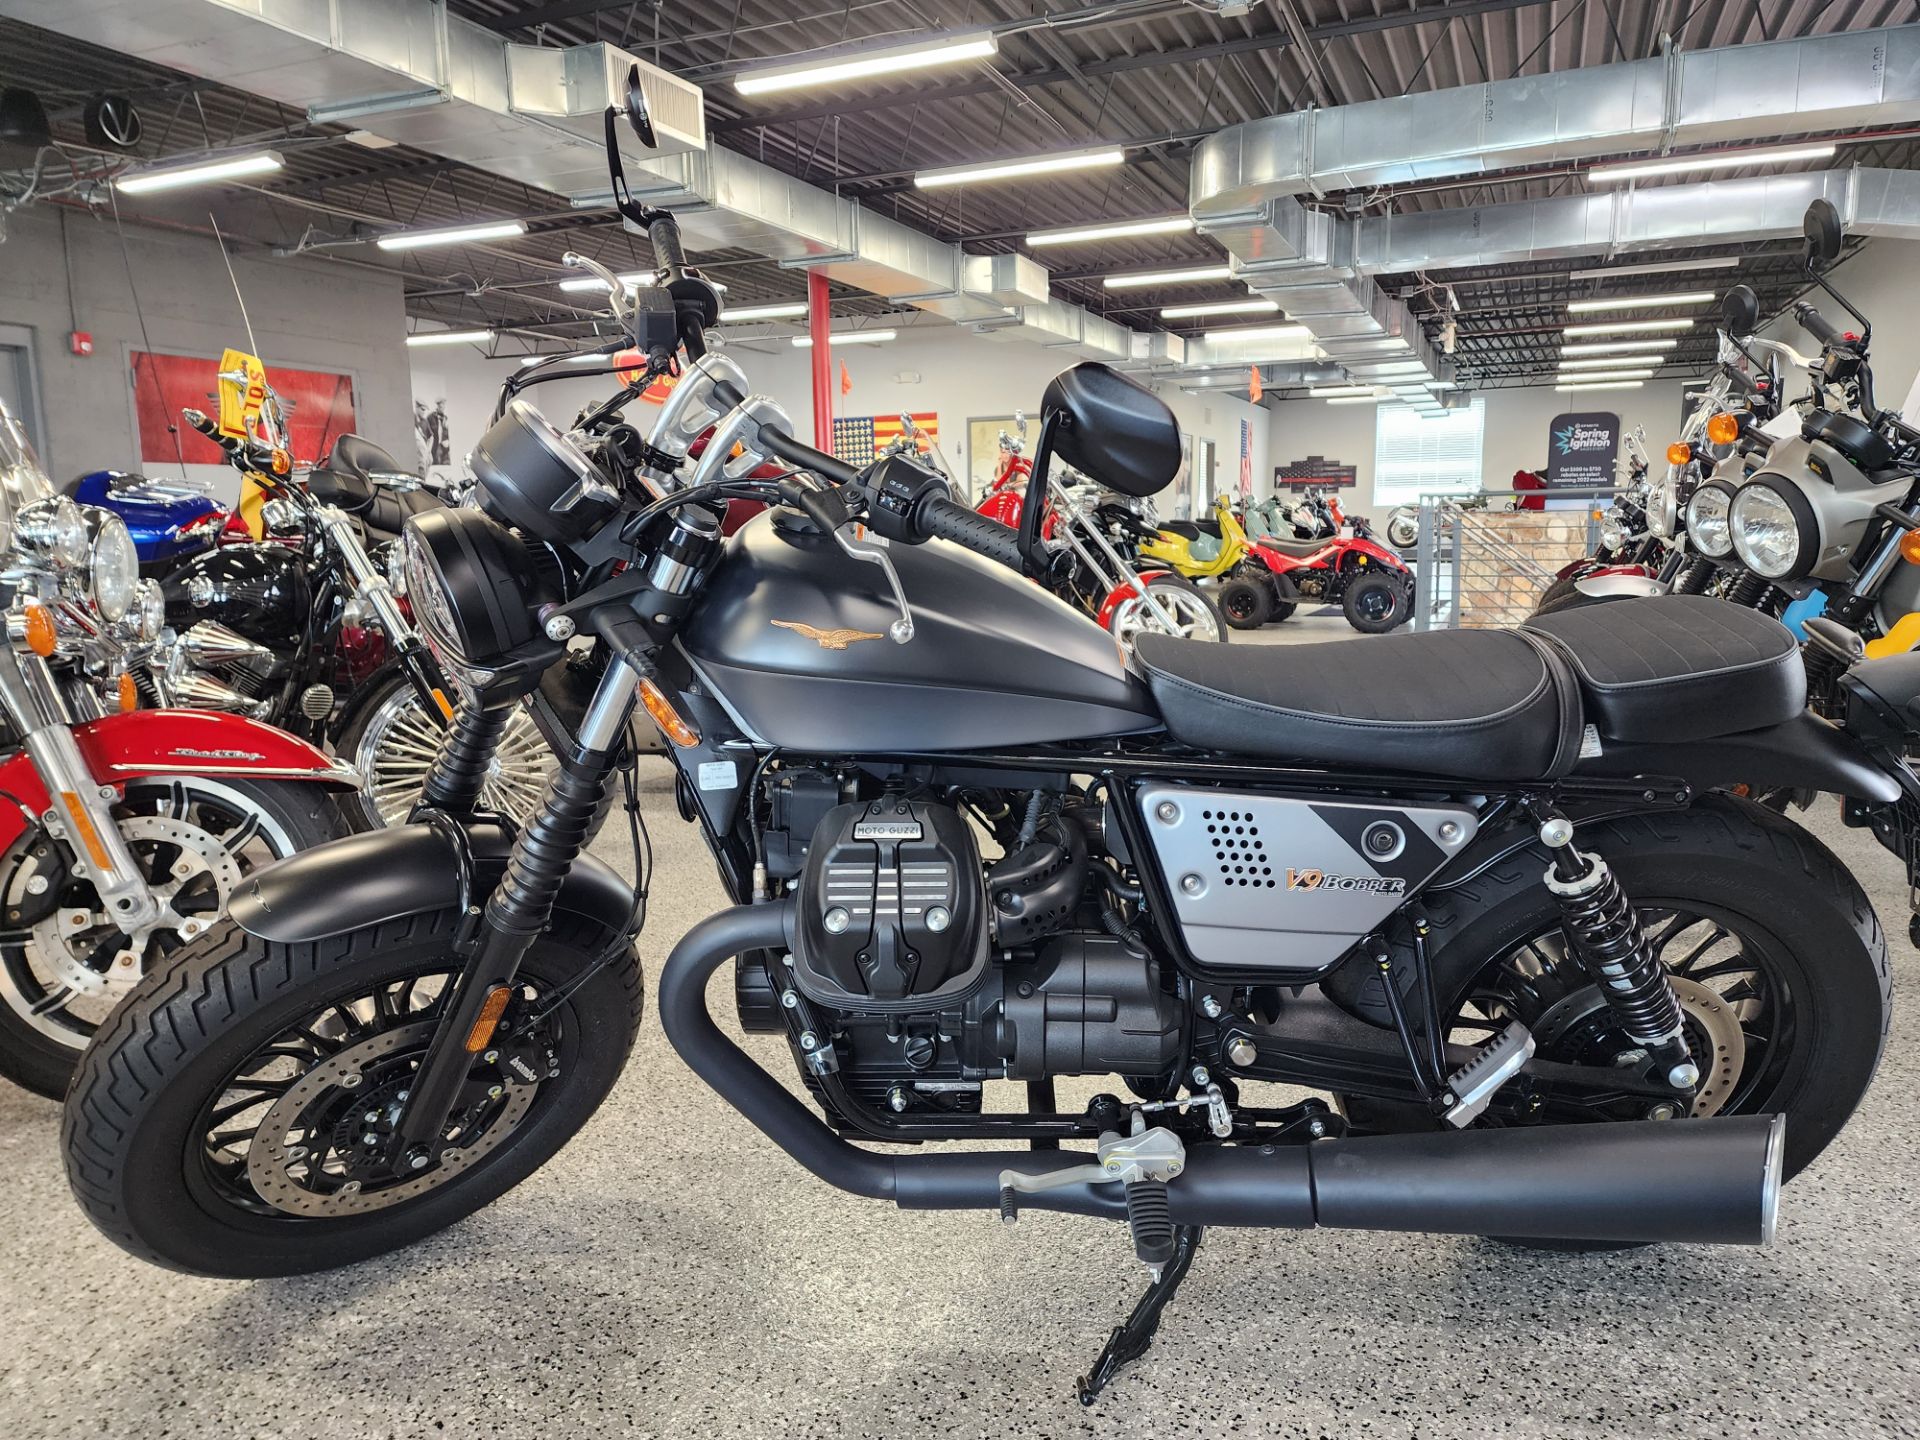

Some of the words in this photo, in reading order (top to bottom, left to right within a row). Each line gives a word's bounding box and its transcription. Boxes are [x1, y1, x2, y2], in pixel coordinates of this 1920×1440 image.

[1574, 428, 1609, 440] Spring
[1569, 438, 1610, 449] Ignition
[857, 826, 885, 835] MOTO
[888, 826, 919, 835] GUZZI
[1285, 867, 1323, 892] V9
[509, 1055, 538, 1081] brembo
